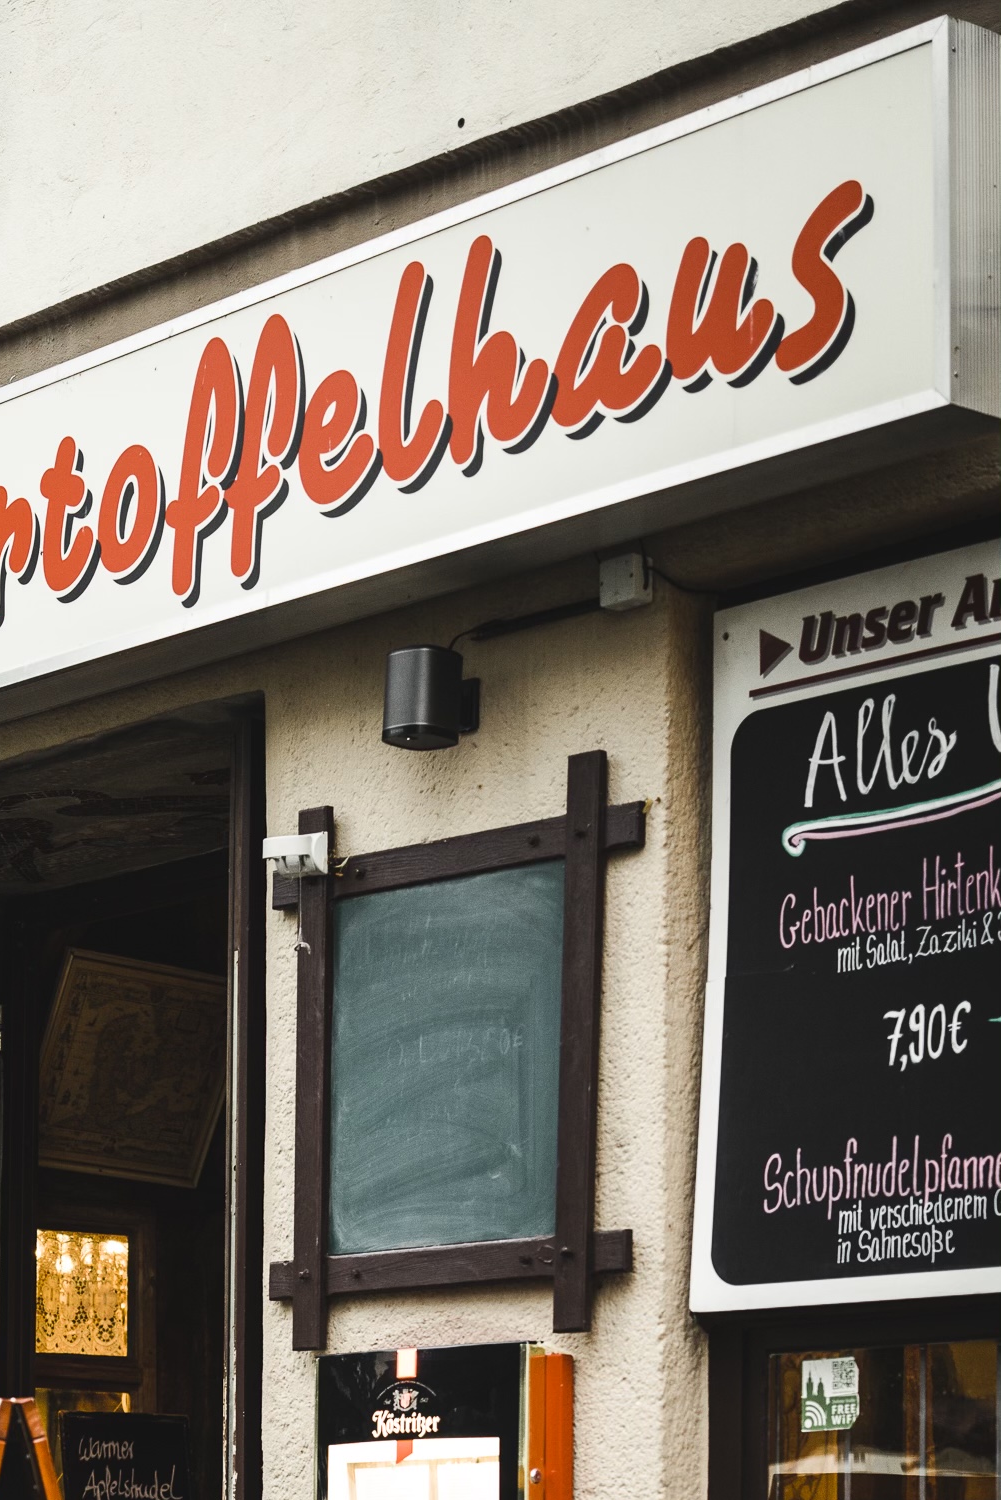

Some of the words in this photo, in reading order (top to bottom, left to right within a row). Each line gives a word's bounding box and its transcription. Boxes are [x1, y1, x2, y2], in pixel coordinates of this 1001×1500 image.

[798, 592, 946, 667] Unser
[803, 694, 958, 808] Alles
[779, 875, 912, 949] Gebackener
[837, 936, 863, 973] mit
[866, 931, 913, 969] Salat,
[915, 919, 977, 957] Zaziki
[980, 911, 994, 944] &
[883, 1000, 972, 1072] 7,90€
[837, 1200, 864, 1235] mit
[870, 1193, 987, 1232] verschiedenem
[837, 1239, 851, 1263] in
[856, 1224, 955, 1263] Sahnesoße
[371, 1410, 441, 1438] Köstritzer
[831, 1403, 856, 1414] FREE
[79, 1437, 134, 1462] Warmer
